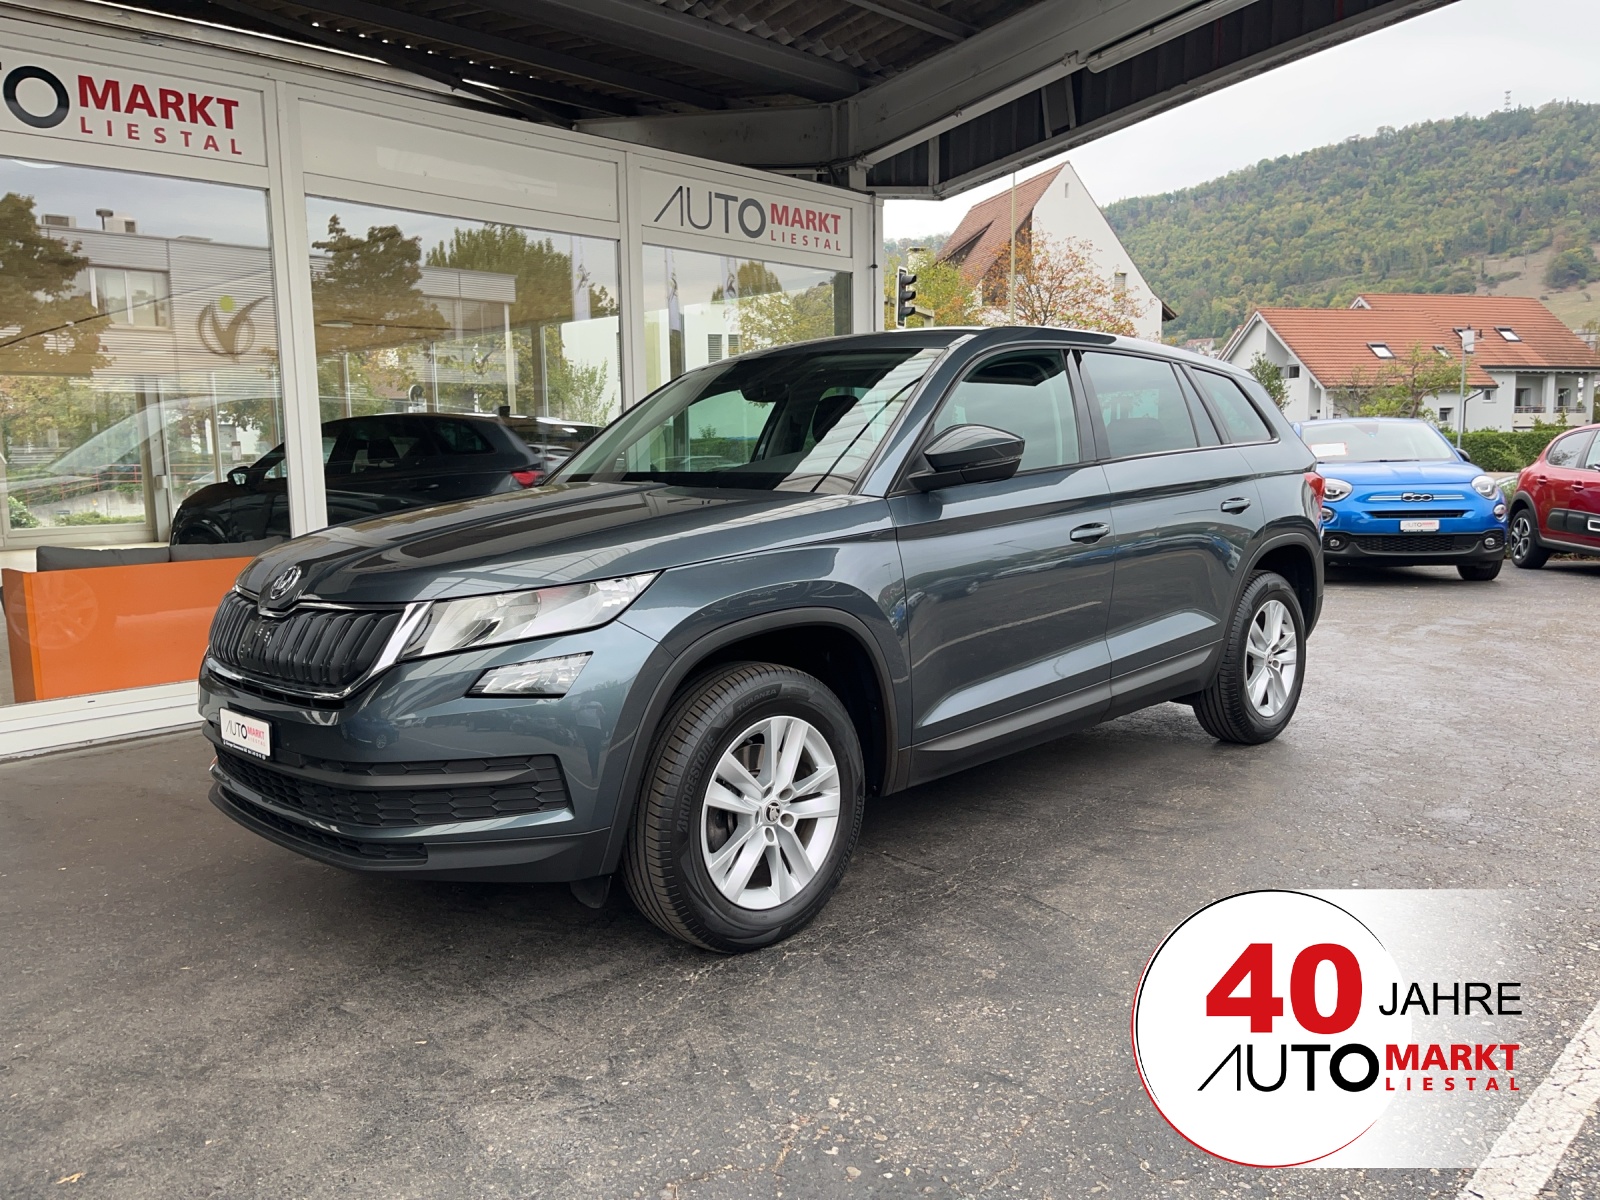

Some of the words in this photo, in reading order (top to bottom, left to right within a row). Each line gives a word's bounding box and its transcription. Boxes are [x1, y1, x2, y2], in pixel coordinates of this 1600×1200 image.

[78, 74, 239, 130] MARKT
[80, 116, 242, 155] LIESTAL
[654, 185, 767, 239] AUTO
[770, 203, 841, 235] MARKT
[770, 230, 841, 251] LIESTAL
[676, 734, 717, 833] BRIDGESTONE
